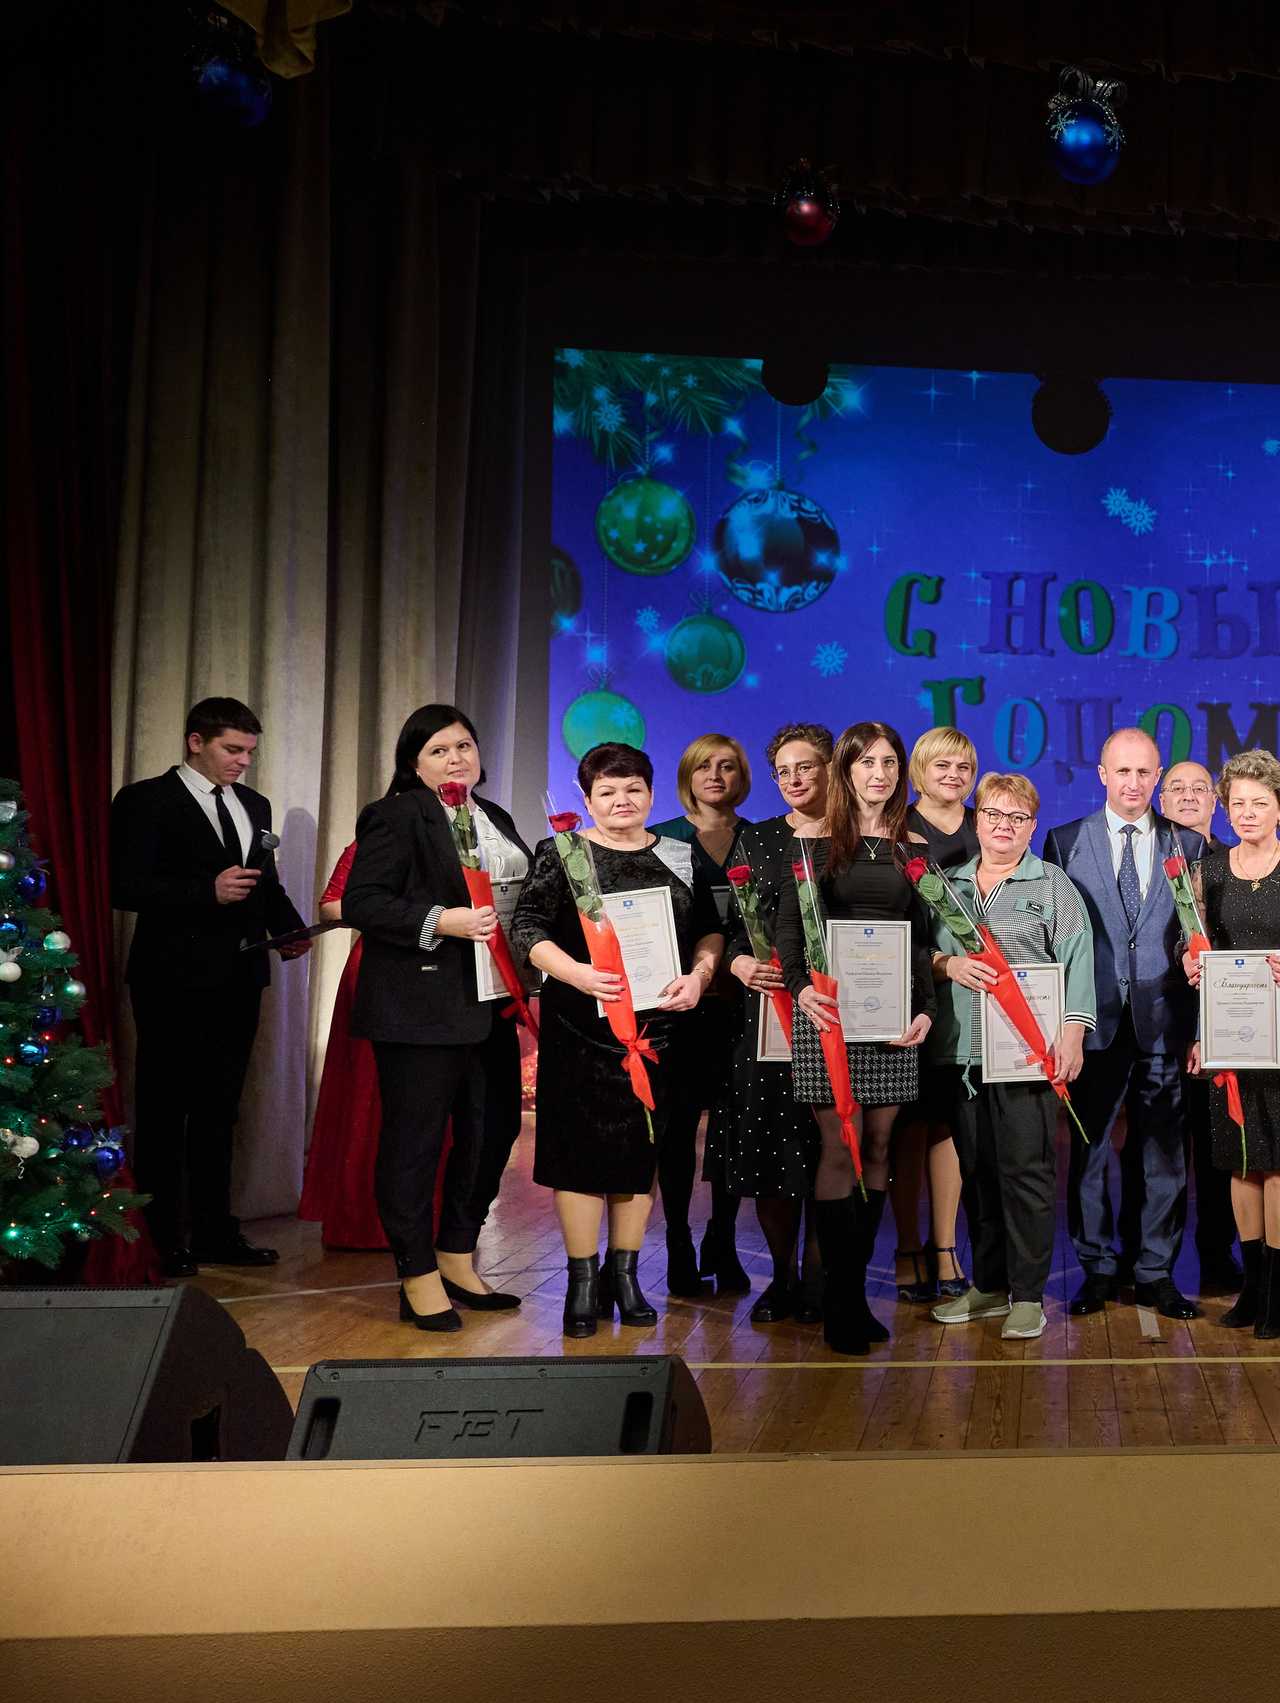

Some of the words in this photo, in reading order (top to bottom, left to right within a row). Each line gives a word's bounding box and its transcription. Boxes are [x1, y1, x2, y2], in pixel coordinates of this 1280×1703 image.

[885, 571, 945, 659] С
[1213, 978, 1268, 991] Благодарность
[414, 1408, 544, 1442] FBT
